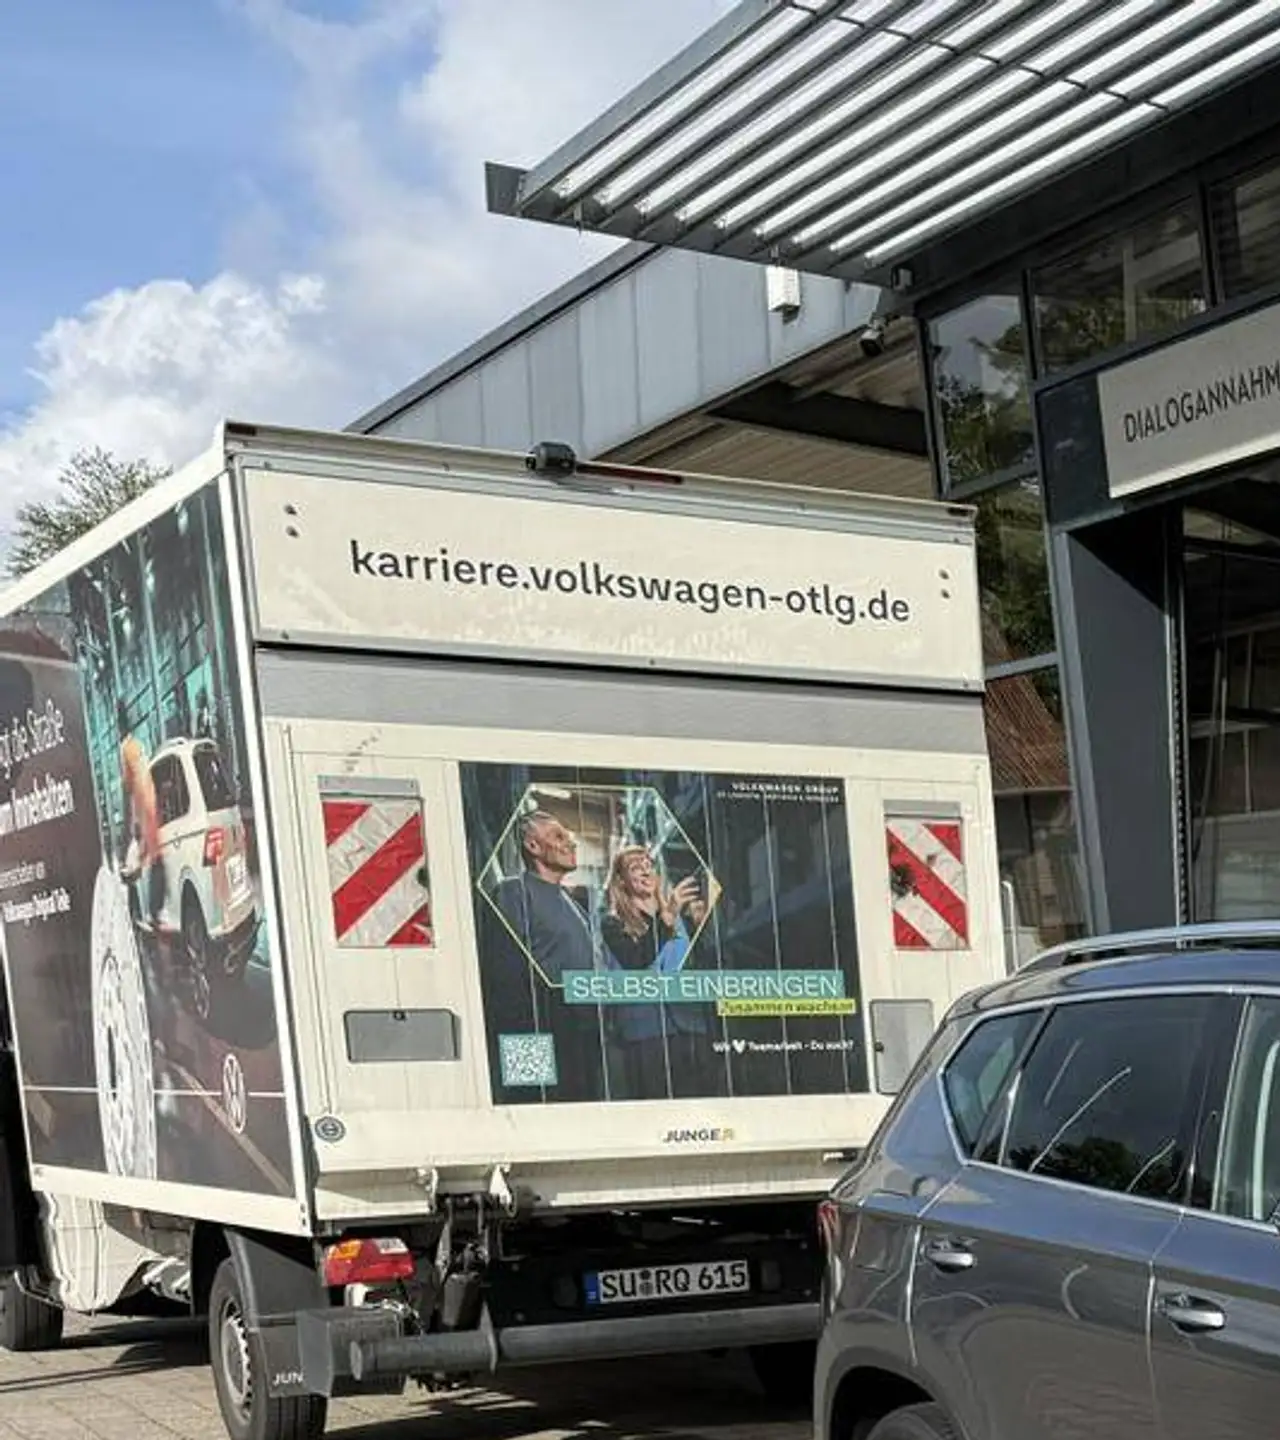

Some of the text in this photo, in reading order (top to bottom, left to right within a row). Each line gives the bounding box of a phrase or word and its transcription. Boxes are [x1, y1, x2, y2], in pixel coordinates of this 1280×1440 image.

[350, 540, 911, 625] karriere.volkswagen-otlg.de
[572, 975, 838, 999] SELBST EINBRINGEN
[602, 1262, 747, 1299] SU RQ 615
